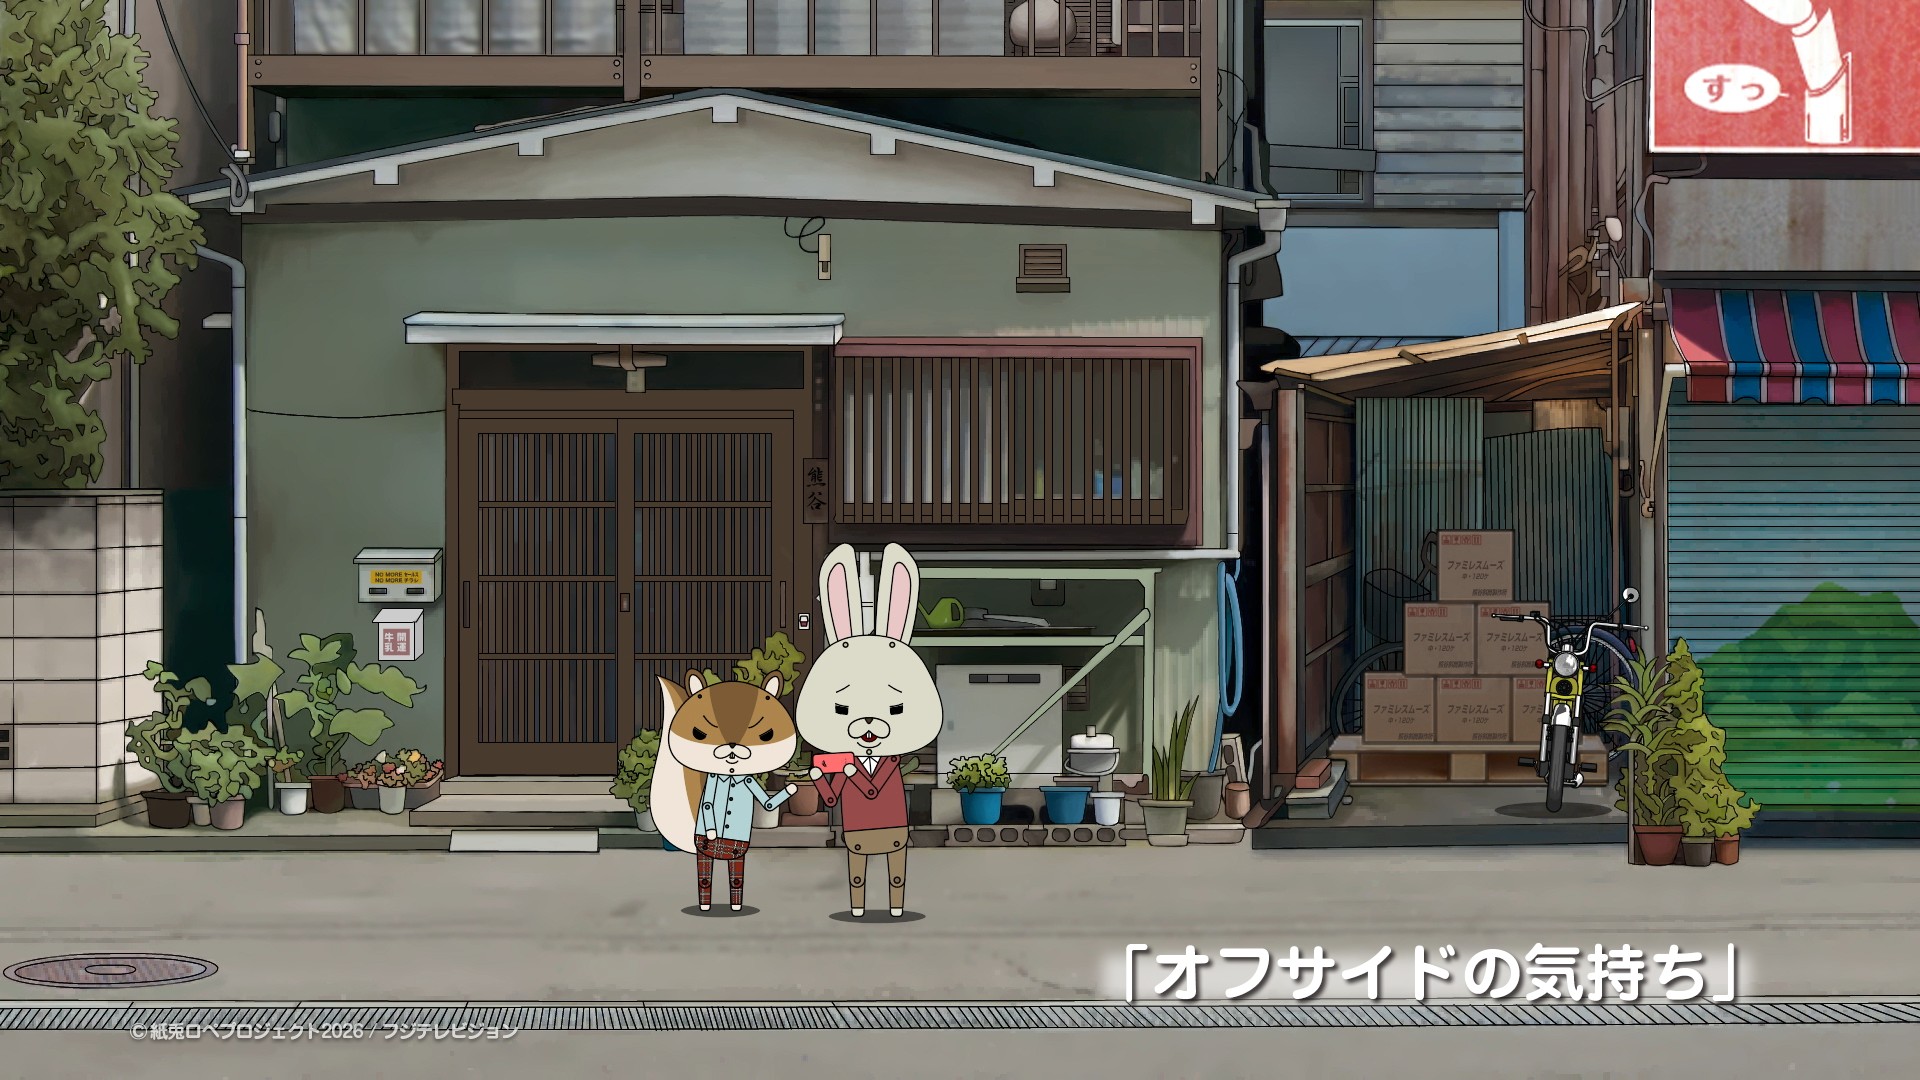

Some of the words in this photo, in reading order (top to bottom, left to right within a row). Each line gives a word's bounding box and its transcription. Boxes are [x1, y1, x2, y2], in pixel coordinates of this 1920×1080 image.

[1702, 74, 1766, 103] すっ
[806, 466, 827, 511] 熊谷
[1447, 559, 1506, 571] ファミレスムーズ
[384, 632, 394, 653] 牛乳
[396, 632, 407, 653] 開運
[1413, 632, 1471, 642] ファミレスムーズ
[1373, 704, 1431, 714] ファミレスムーズ
[1447, 704, 1505, 714] ファミレスムーズ
